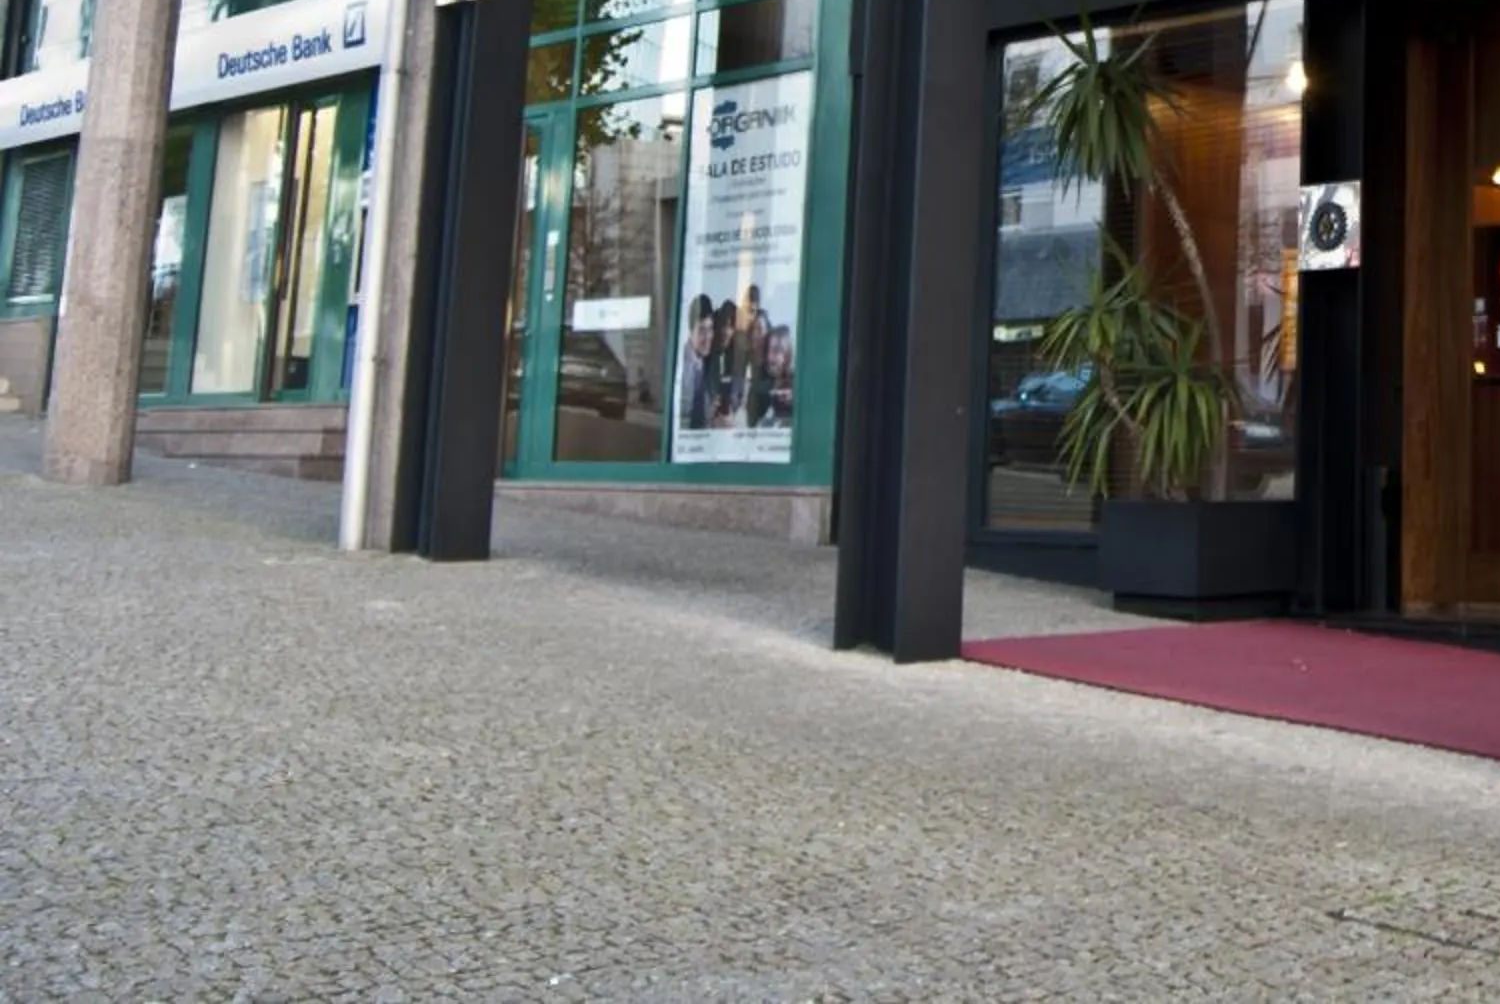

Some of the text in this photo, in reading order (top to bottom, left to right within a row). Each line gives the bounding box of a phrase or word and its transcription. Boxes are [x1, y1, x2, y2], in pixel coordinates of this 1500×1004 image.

[218, 27, 333, 79] Deutsche Bank
[20, 98, 73, 127] Deutsche
[731, 156, 747, 176] DE
[750, 150, 801, 174] ESTUDO
